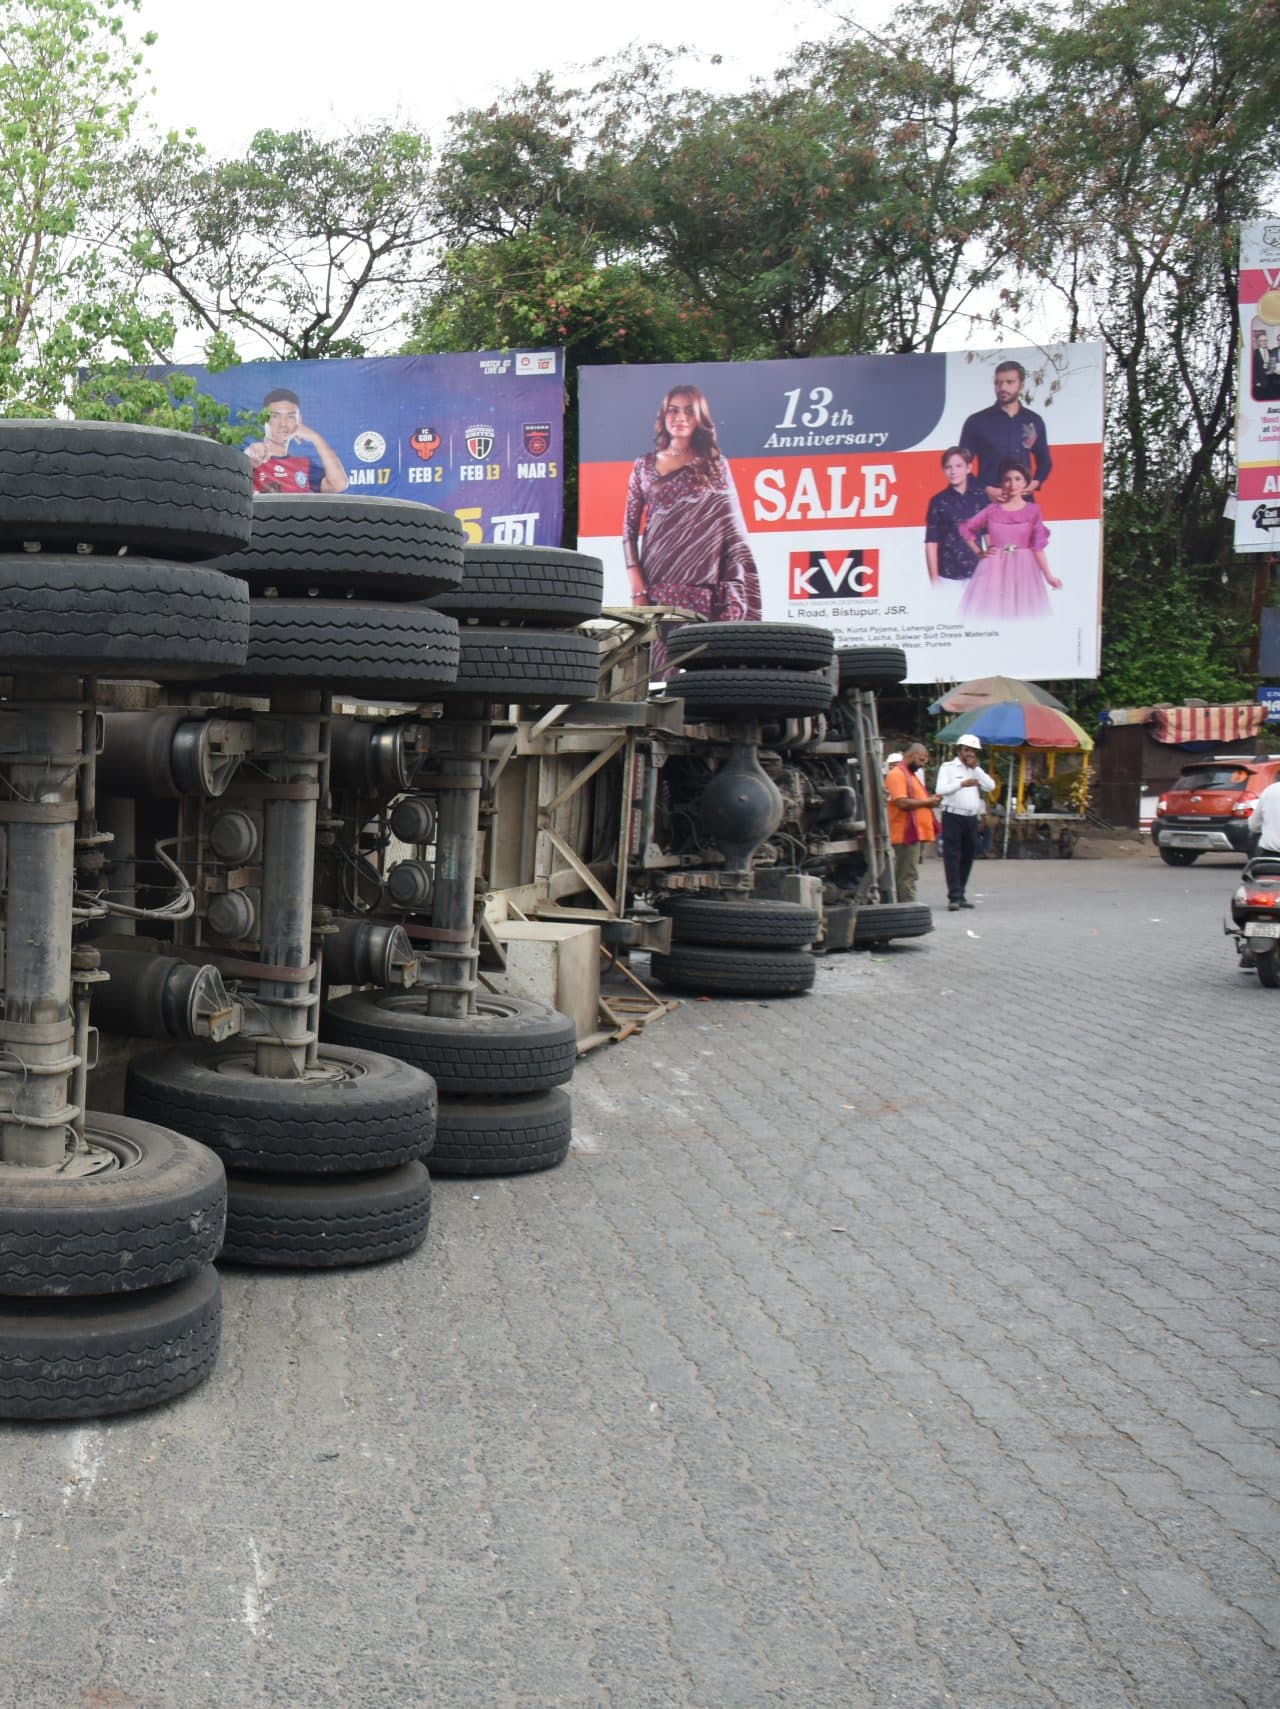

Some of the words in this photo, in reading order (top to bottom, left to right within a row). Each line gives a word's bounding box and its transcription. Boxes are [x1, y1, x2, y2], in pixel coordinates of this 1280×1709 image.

[775, 386, 855, 429] 13th
[763, 431, 889, 448] Anniversary
[349, 468, 375, 485] JAN
[377, 467, 391, 485] 17
[408, 467, 432, 483] FEB
[433, 466, 443, 483] 2
[460, 464, 484, 481] FEB
[486, 463, 500, 480] 13
[517, 462, 546, 479] MAR
[548, 461, 558, 478] 5
[753, 464, 898, 521] SALE
[793, 557, 874, 595] KVC
